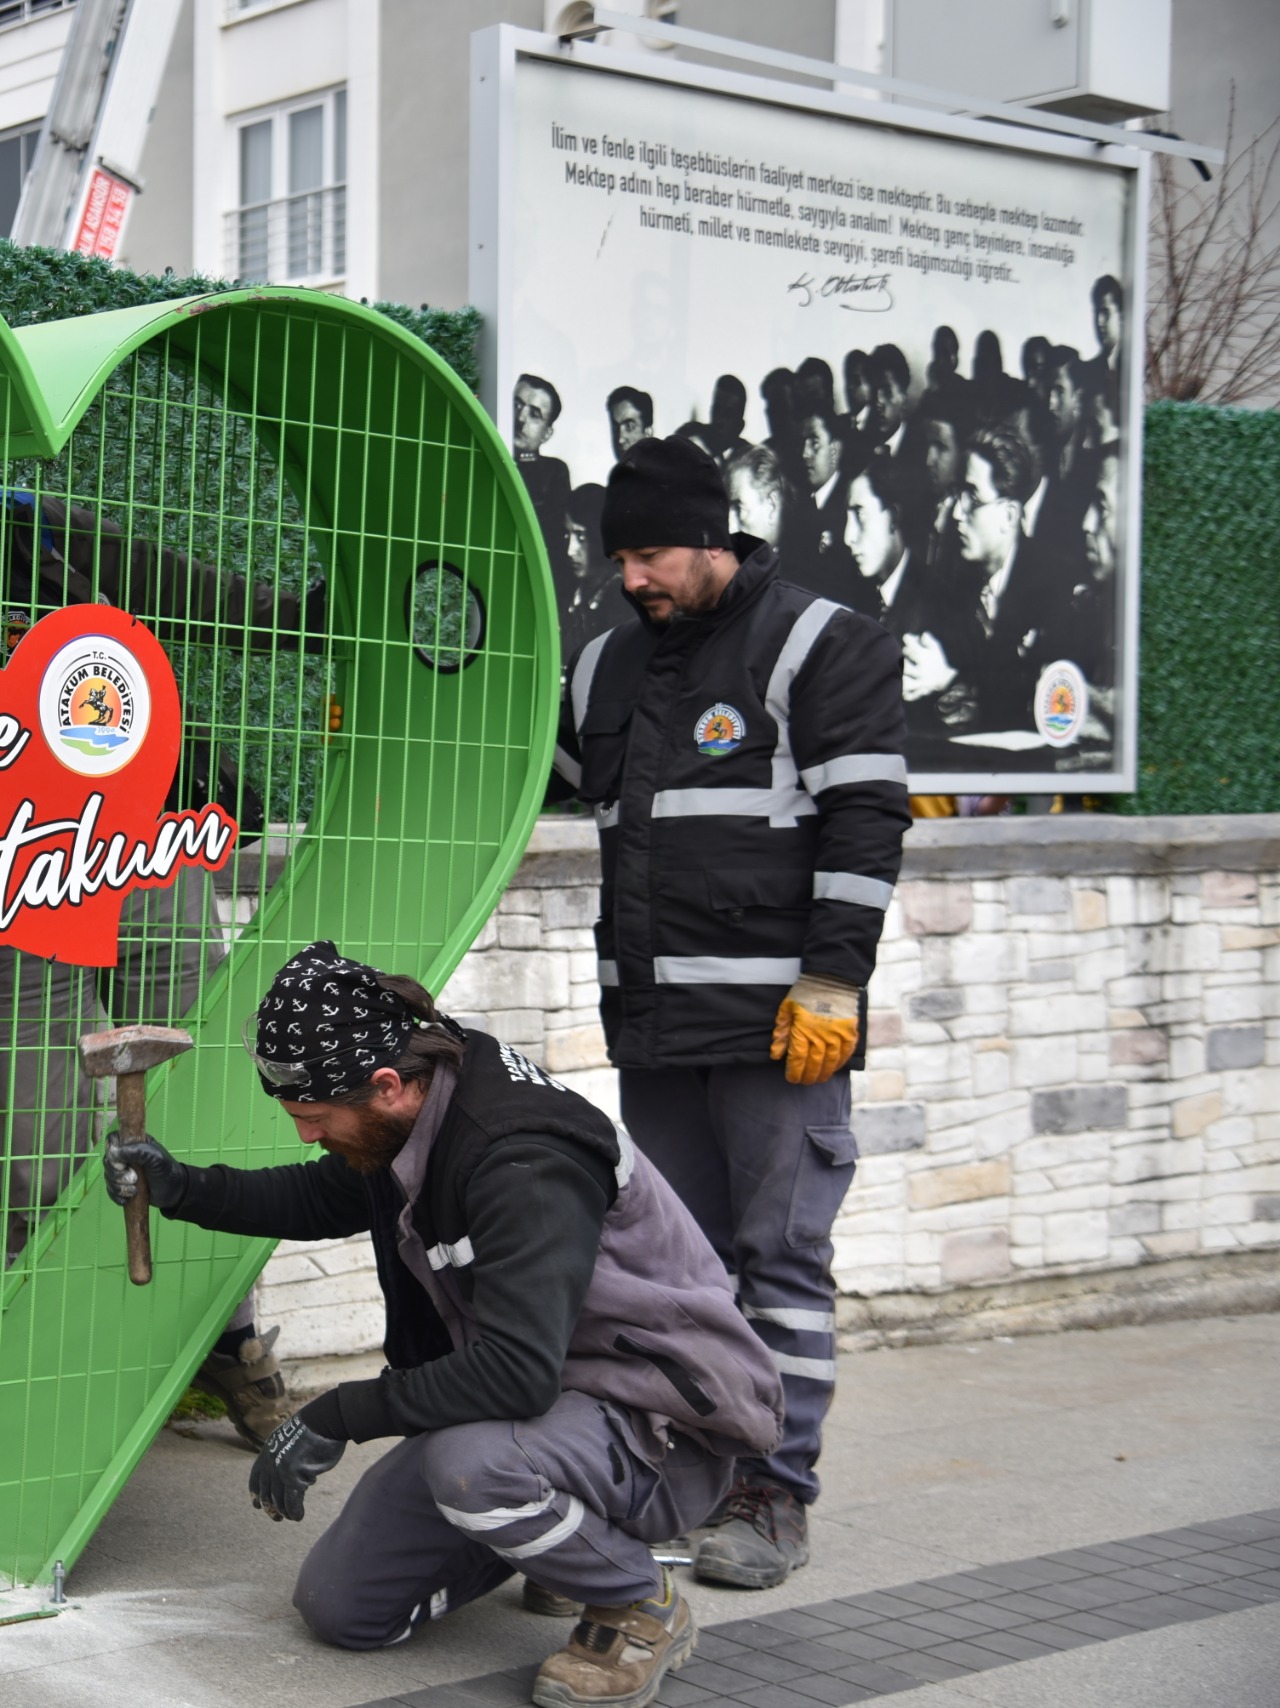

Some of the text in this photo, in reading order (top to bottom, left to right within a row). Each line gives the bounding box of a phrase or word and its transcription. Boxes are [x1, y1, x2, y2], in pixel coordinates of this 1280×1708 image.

[83, 174, 112, 231] ASANSÖR
[552, 121, 577, 151] İlim
[582, 137, 597, 155] ve
[601, 135, 635, 160] fenle
[639, 141, 667, 169] ilgili
[671, 148, 756, 182] teşebbüslerin
[760, 162, 804, 192] faaliyet
[807, 175, 853, 199] merkezi
[857, 179, 873, 201] ise
[877, 186, 933, 215] mekteptir.
[936, 193, 951, 214] Bu
[954, 199, 996, 225] sebeple
[999, 207, 1038, 234] mektep
[565, 161, 615, 195] Mektep
[620, 171, 652, 196] adını
[656, 175, 679, 205] hep
[684, 180, 733, 209] beraber
[798, 204, 846, 231] saygıyla
[849, 212, 892, 236] analım!
[899, 216, 940, 243] Mektep
[943, 227, 970, 252] genç
[1028, 238, 1074, 267] insanlığa
[640, 205, 694, 235] hürmeti,
[698, 215, 733, 240] millet
[736, 224, 750, 242] ve
[754, 227, 819, 253] memlekete
[871, 244, 903, 268] şerefi
[907, 250, 973, 281] bağımsızlığı
[92, 651, 106, 660] T.C.
[61, 666, 132, 734] ATAKUM BELEDİYESİ
